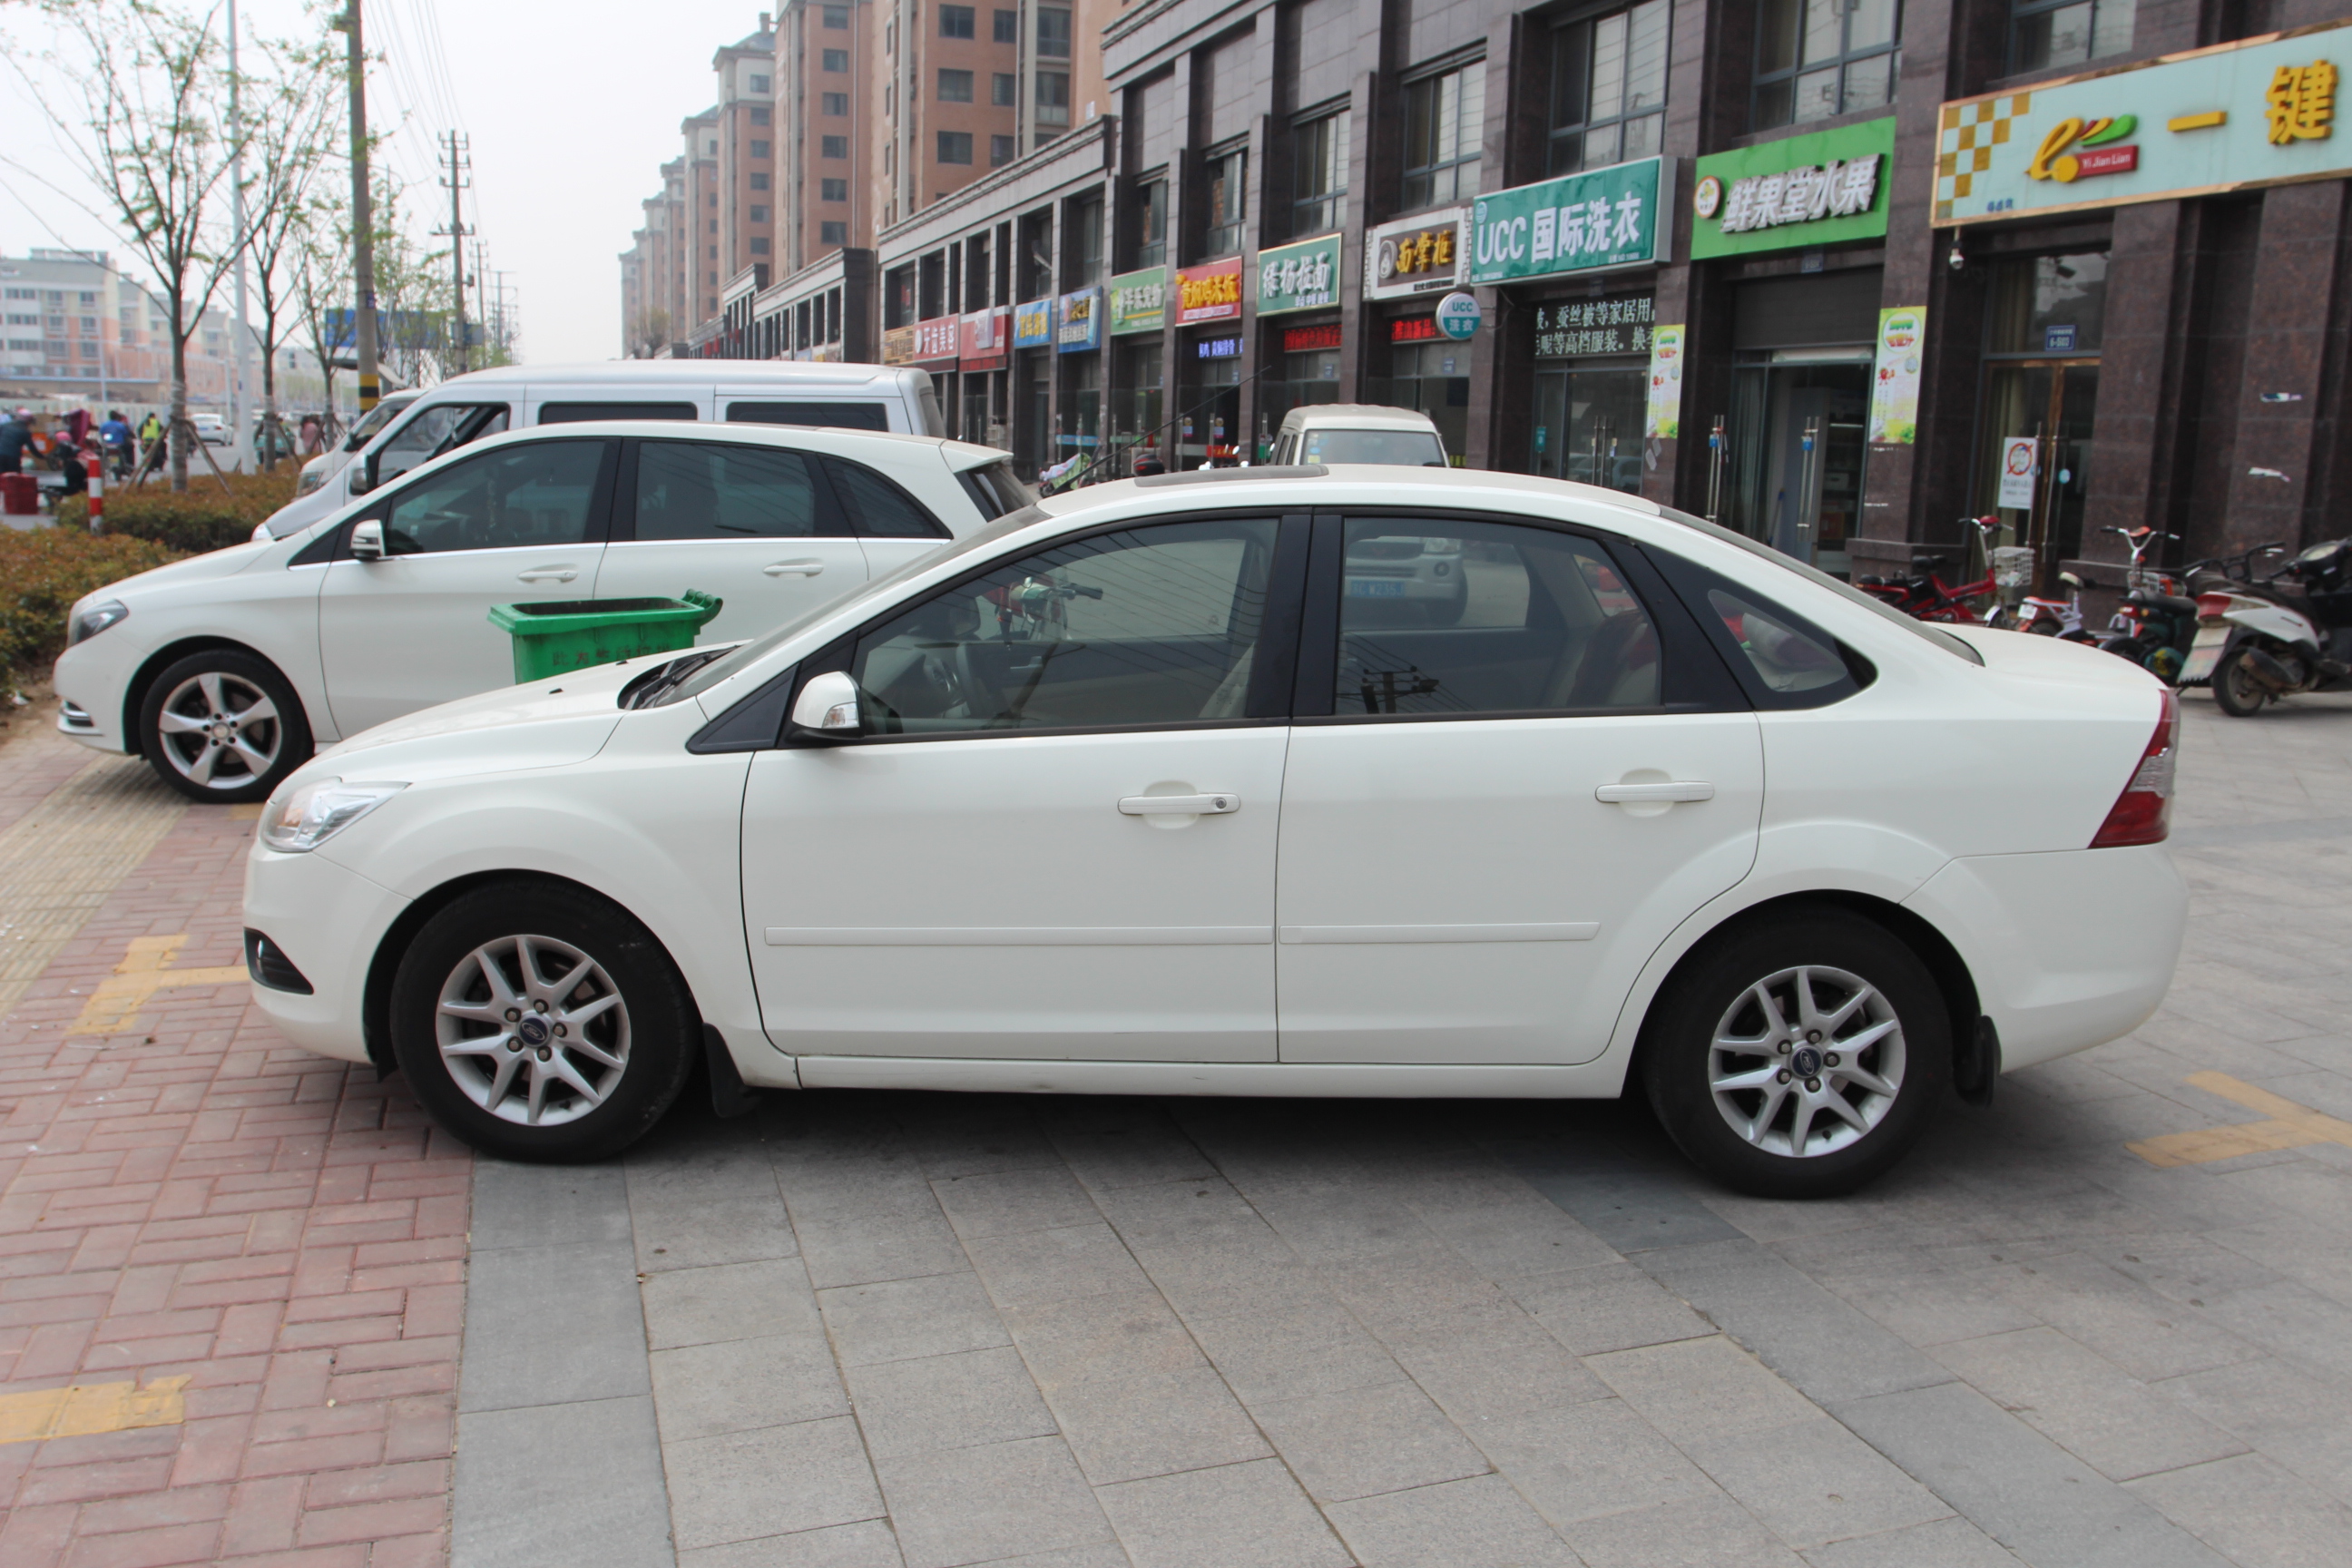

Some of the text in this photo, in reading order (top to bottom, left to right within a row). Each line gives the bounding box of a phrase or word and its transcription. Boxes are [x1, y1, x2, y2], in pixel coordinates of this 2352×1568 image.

[2167, 59, 2339, 145] 一键
[2082, 153, 2131, 169] Yi Jian Lian
[1721, 153, 1881, 233] 鲜果堂水果
[1477, 216, 1526, 265] UCC
[1531, 191, 1642, 264] 国际洗衣
[1449, 318, 1473, 332] 洗衣
[1453, 301, 1473, 312] UCC
[1536, 298, 1655, 330] ，蚕丝被等家居用
